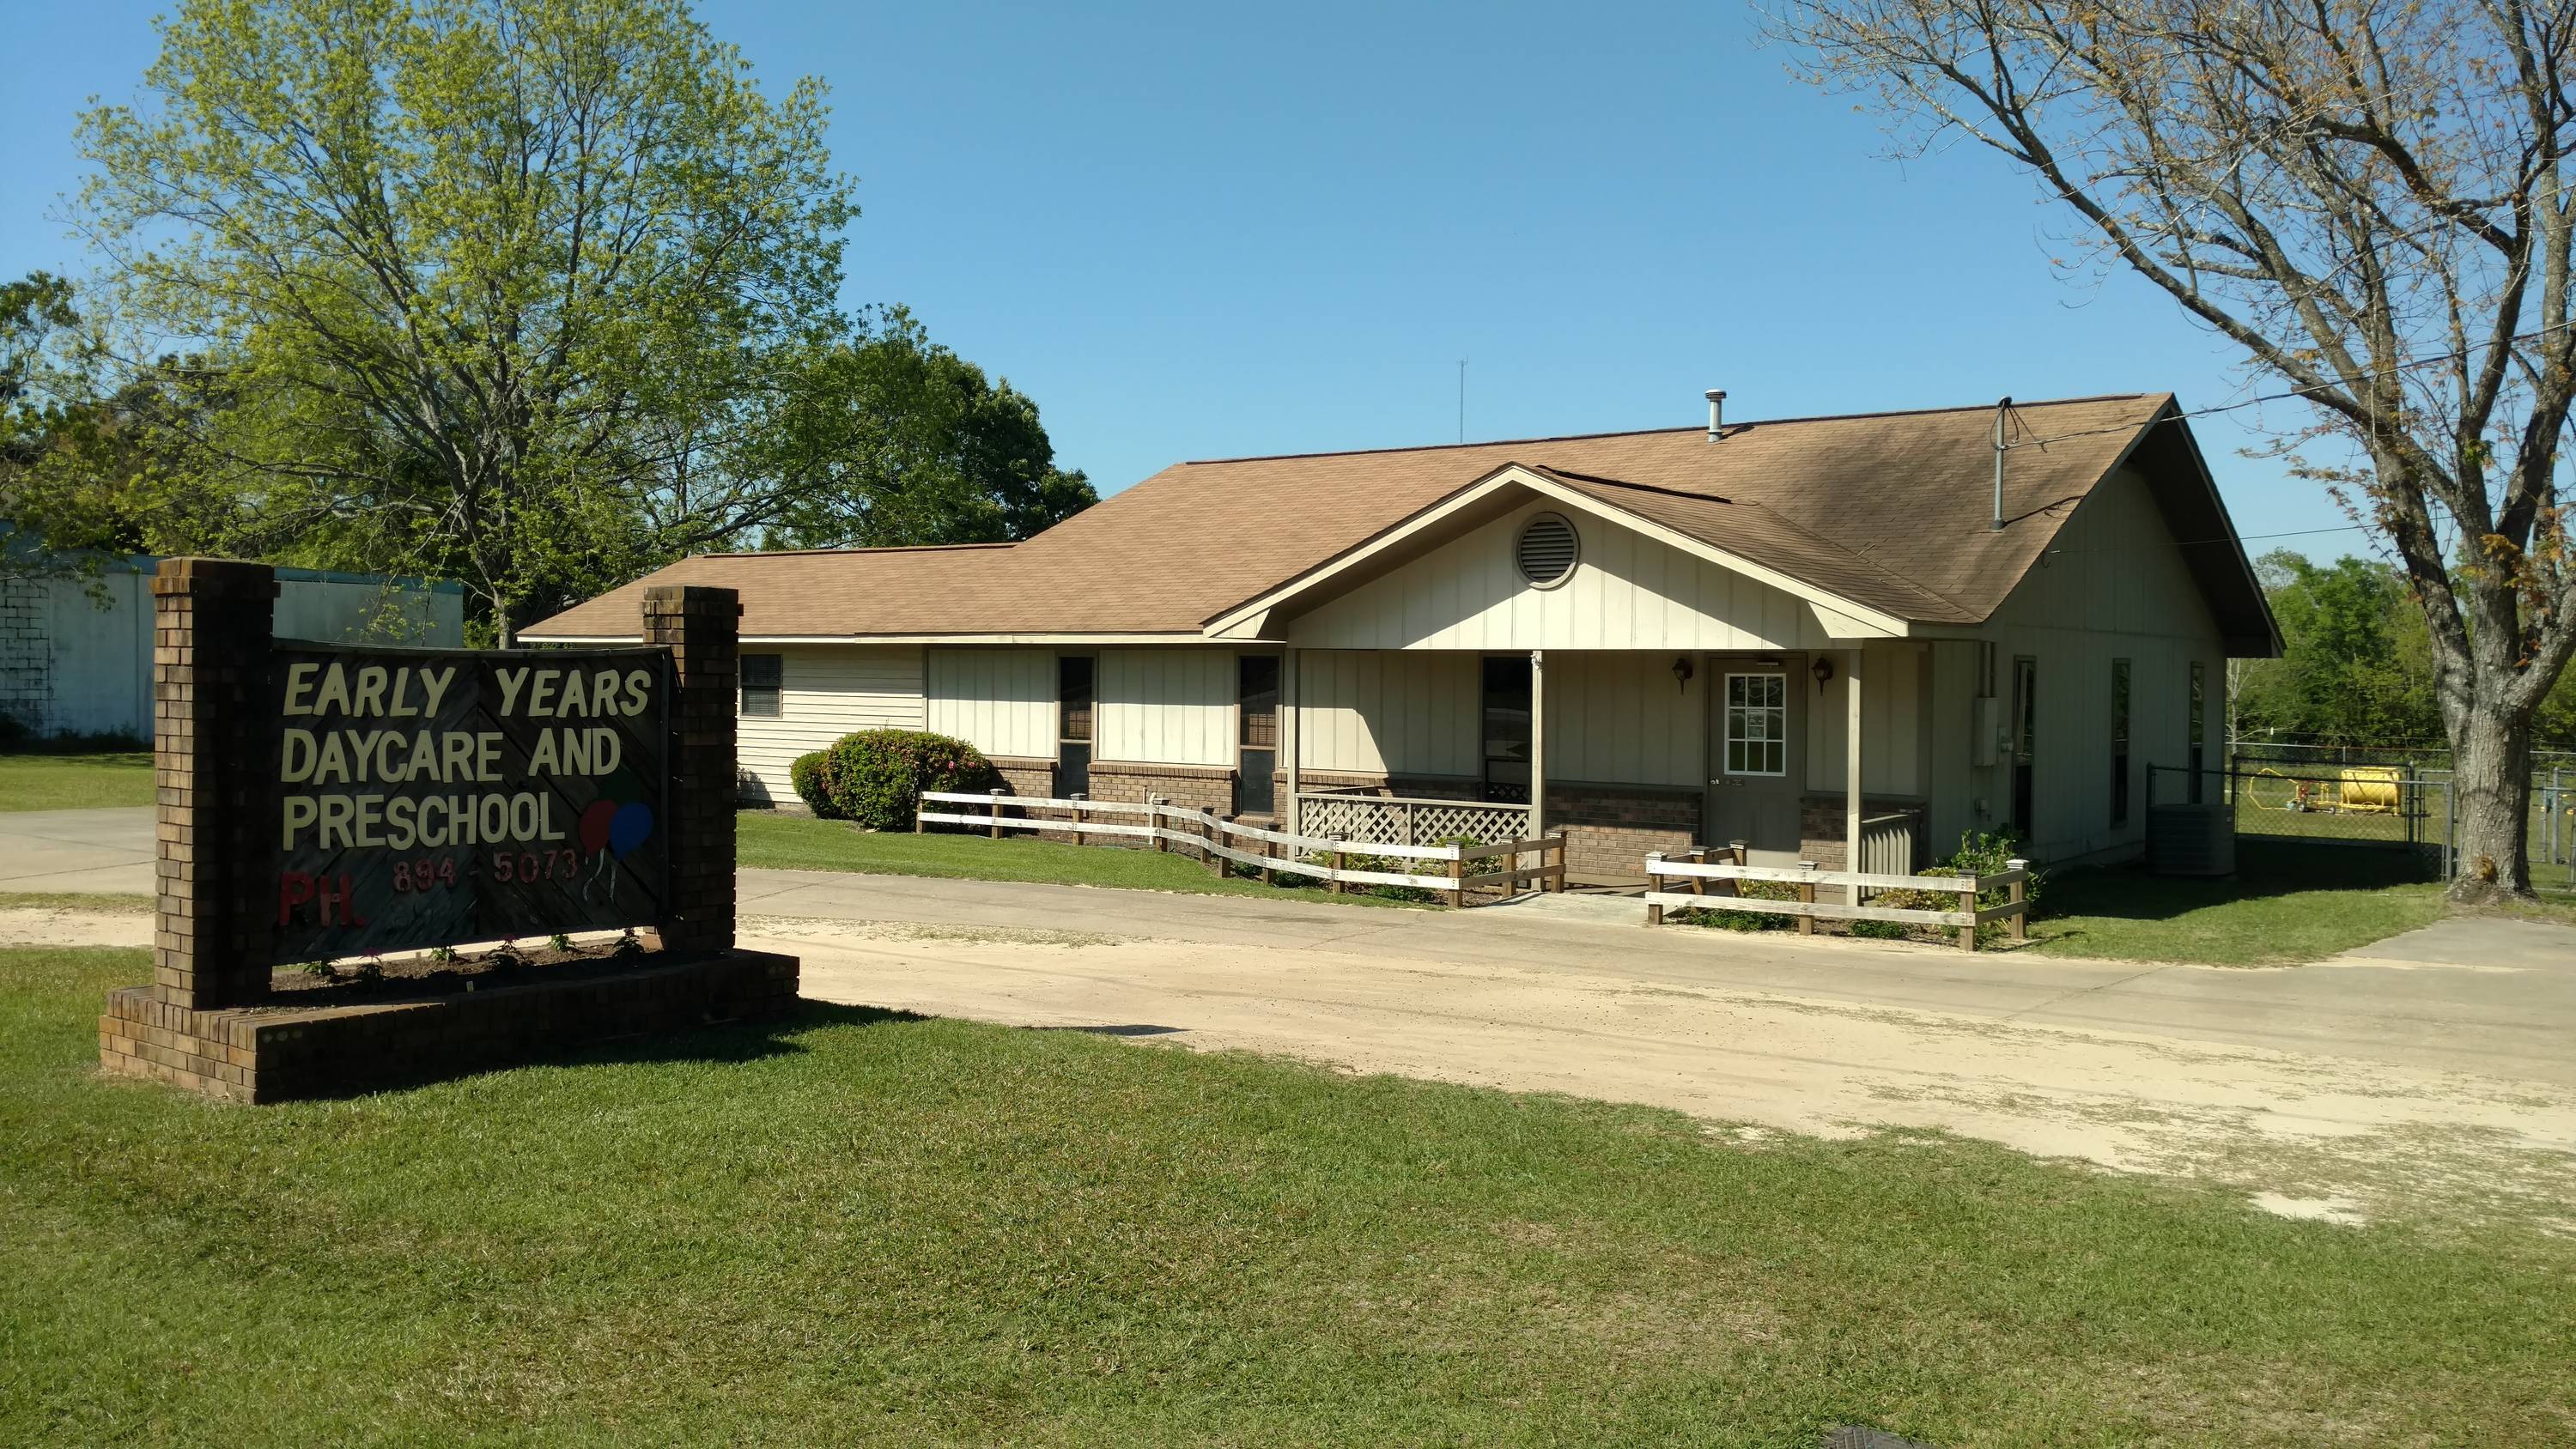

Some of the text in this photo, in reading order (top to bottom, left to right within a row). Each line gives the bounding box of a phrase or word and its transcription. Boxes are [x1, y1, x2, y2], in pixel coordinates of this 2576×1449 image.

[283, 663, 652, 718] EARLY YEARS
[280, 727, 621, 785] DAYCARE AND
[283, 791, 565, 852] PRESCHOOL
[492, 849, 579, 885] 5073
